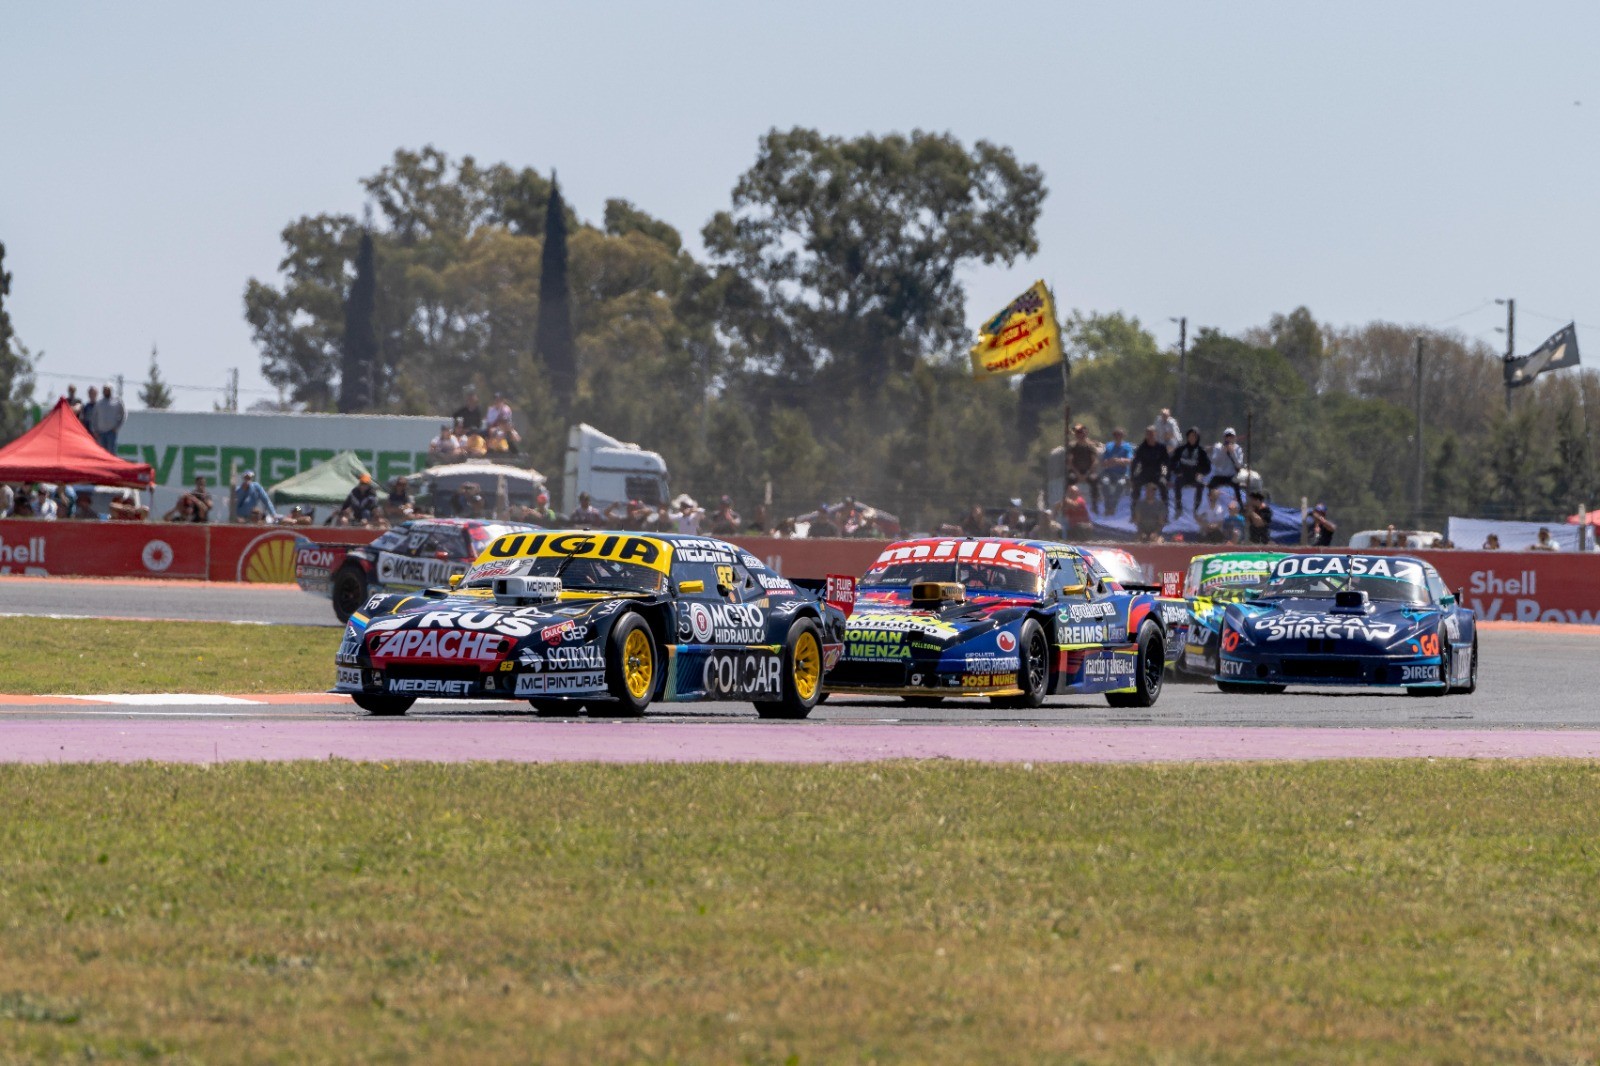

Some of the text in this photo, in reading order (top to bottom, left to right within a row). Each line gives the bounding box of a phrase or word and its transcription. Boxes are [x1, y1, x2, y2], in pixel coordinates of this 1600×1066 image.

[409, 532, 428, 548] 87
[876, 541, 1041, 567] milla
[1277, 556, 1392, 577] OCASA
[1470, 570, 1536, 595] Shell
[836, 590, 854, 602] PARTS
[562, 625, 587, 641] GEP
[714, 628, 766, 644] HIDRAULICA
[1064, 625, 1103, 643] REIMS
[375, 630, 504, 660] APACHE
[850, 644, 912, 659] MENZA
[546, 645, 606, 671] SCIENZA
[388, 678, 474, 693] MEDEMET
[521, 674, 605, 690] MC PINTURAS
[962, 676, 990, 687] JOSE
